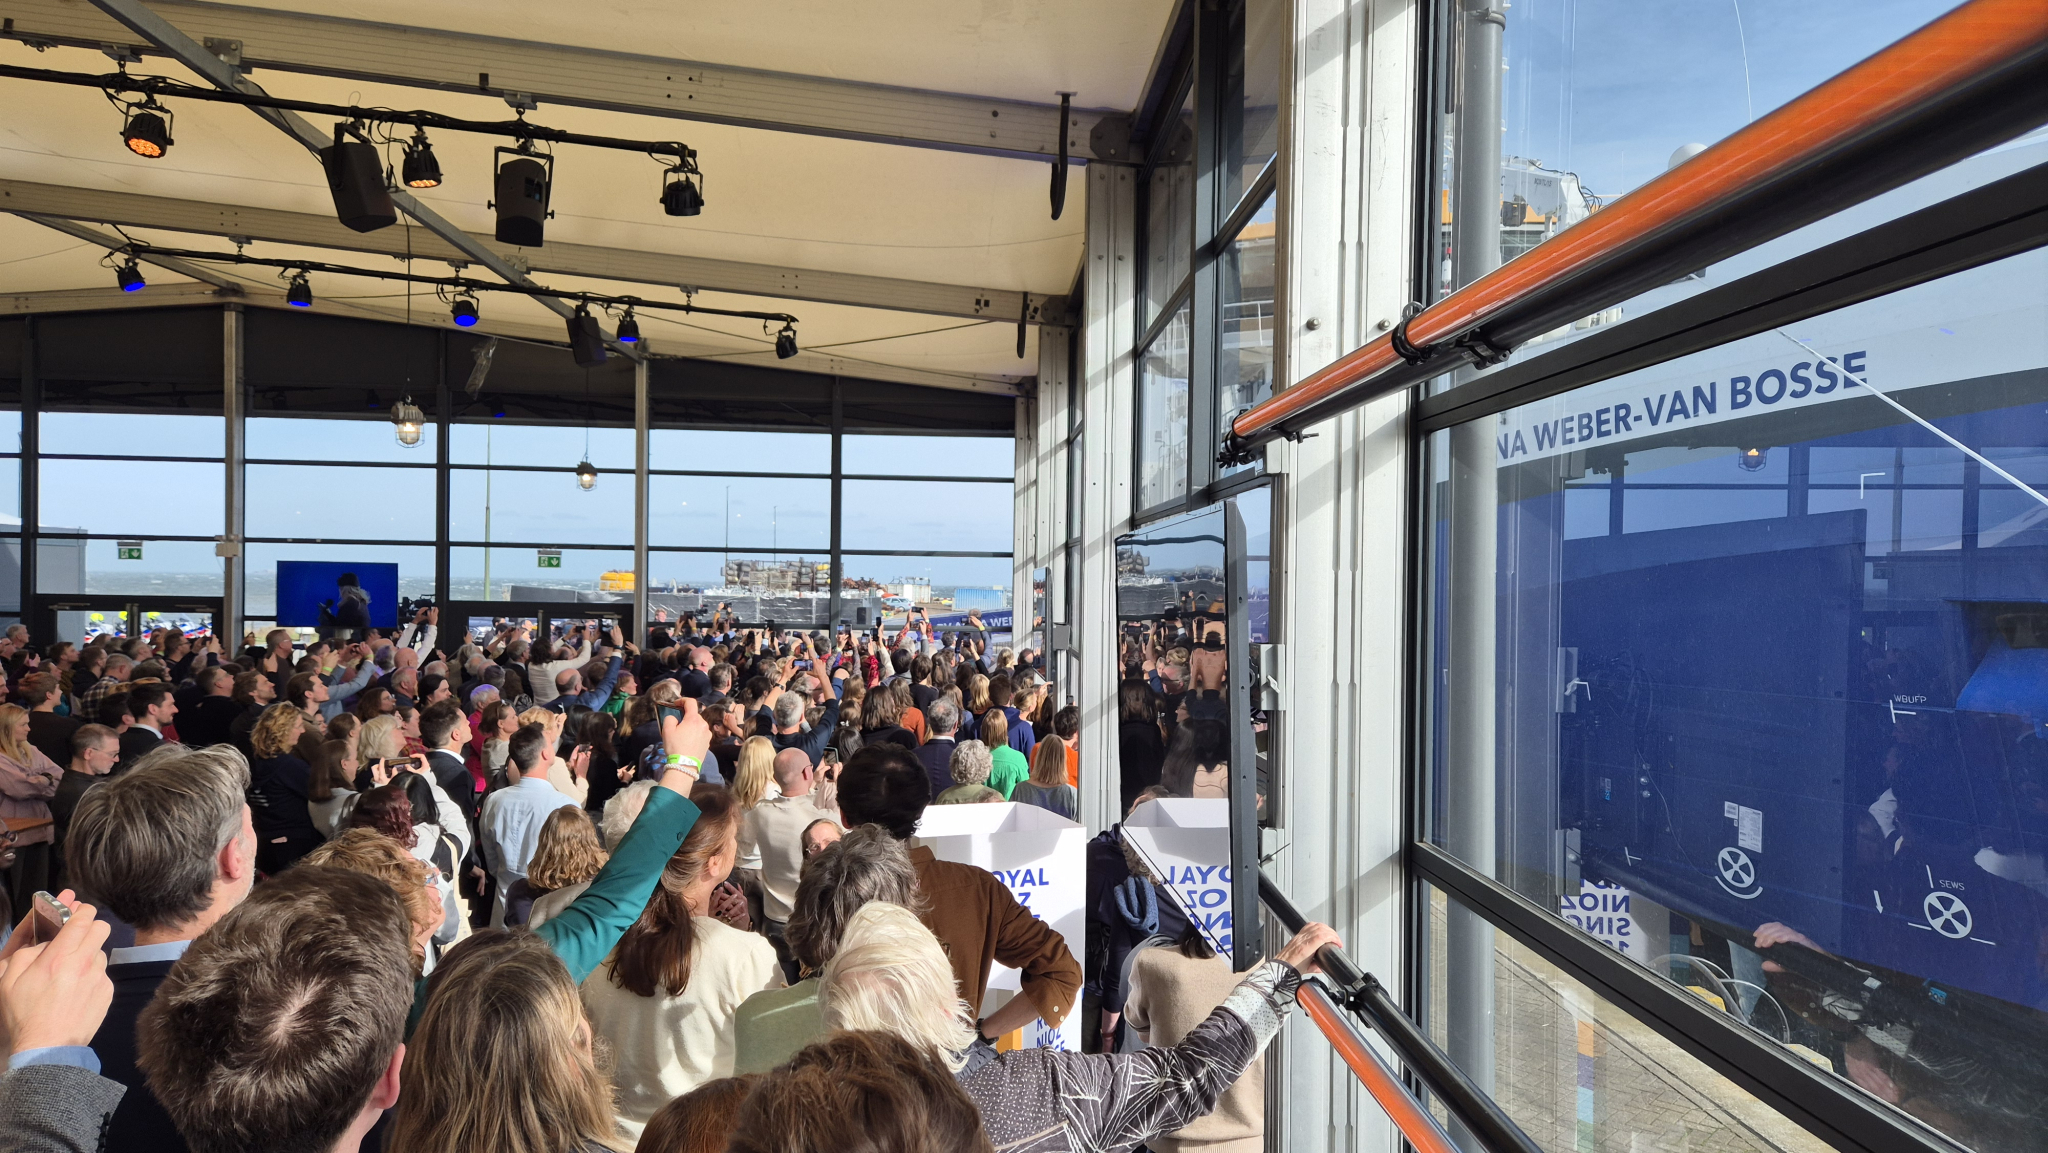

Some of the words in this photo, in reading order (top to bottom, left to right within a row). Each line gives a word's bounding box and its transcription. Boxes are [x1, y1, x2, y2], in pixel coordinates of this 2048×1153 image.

[1533, 382, 1717, 451] WEBER-VAN
[1730, 350, 1868, 411] BOSSE
[1893, 694, 1927, 704] WBUFP
[1939, 879, 1966, 891] SEWS
